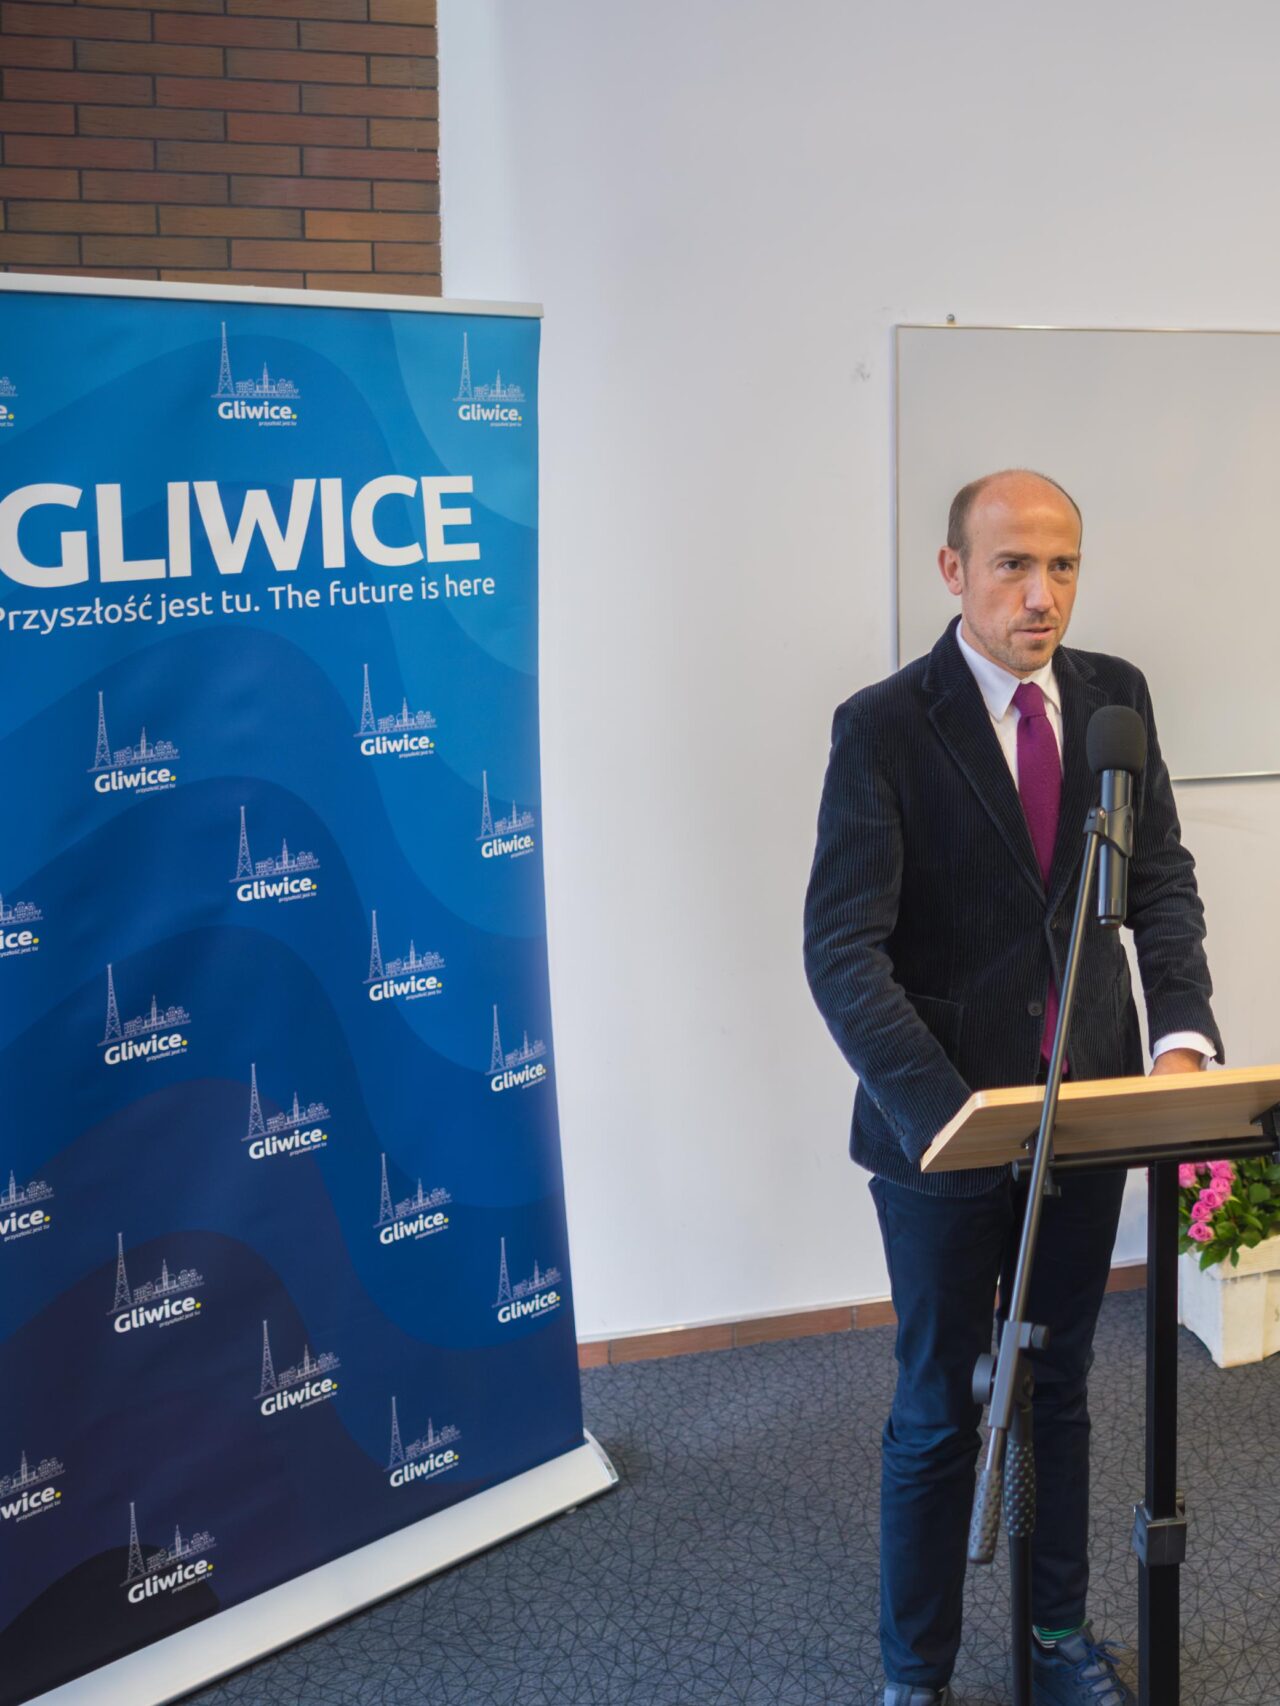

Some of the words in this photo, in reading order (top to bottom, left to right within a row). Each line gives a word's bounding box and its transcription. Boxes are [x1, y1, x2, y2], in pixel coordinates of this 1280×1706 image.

[218, 401, 297, 420] Gliwice.
[458, 404, 522, 421] Gliwice.
[0, 474, 480, 588] GLIWICE
[157, 591, 213, 625] jest
[222, 590, 260, 614] tu.
[267, 583, 320, 610] The
[329, 580, 413, 606] future
[421, 576, 439, 600] is
[445, 573, 495, 598] here
[361, 734, 435, 757] Gliwice.
[94, 767, 176, 793] Gliwice.
[481, 835, 534, 858] Gliwice.
[237, 877, 317, 902] Gliwice.
[369, 976, 443, 1001] Gliwice.
[104, 1034, 188, 1065] Gliwice.
[491, 1063, 547, 1092] Gliwice.
[249, 1128, 328, 1160] Gliwice.
[380, 1212, 449, 1245] Gliwice.
[114, 1297, 201, 1333] Gliwice.
[498, 1291, 560, 1323] Gliwice.
[261, 1378, 338, 1416] Gliwice.
[390, 1450, 459, 1488] Gliwice.
[128, 1560, 214, 1604] Gliwice.
